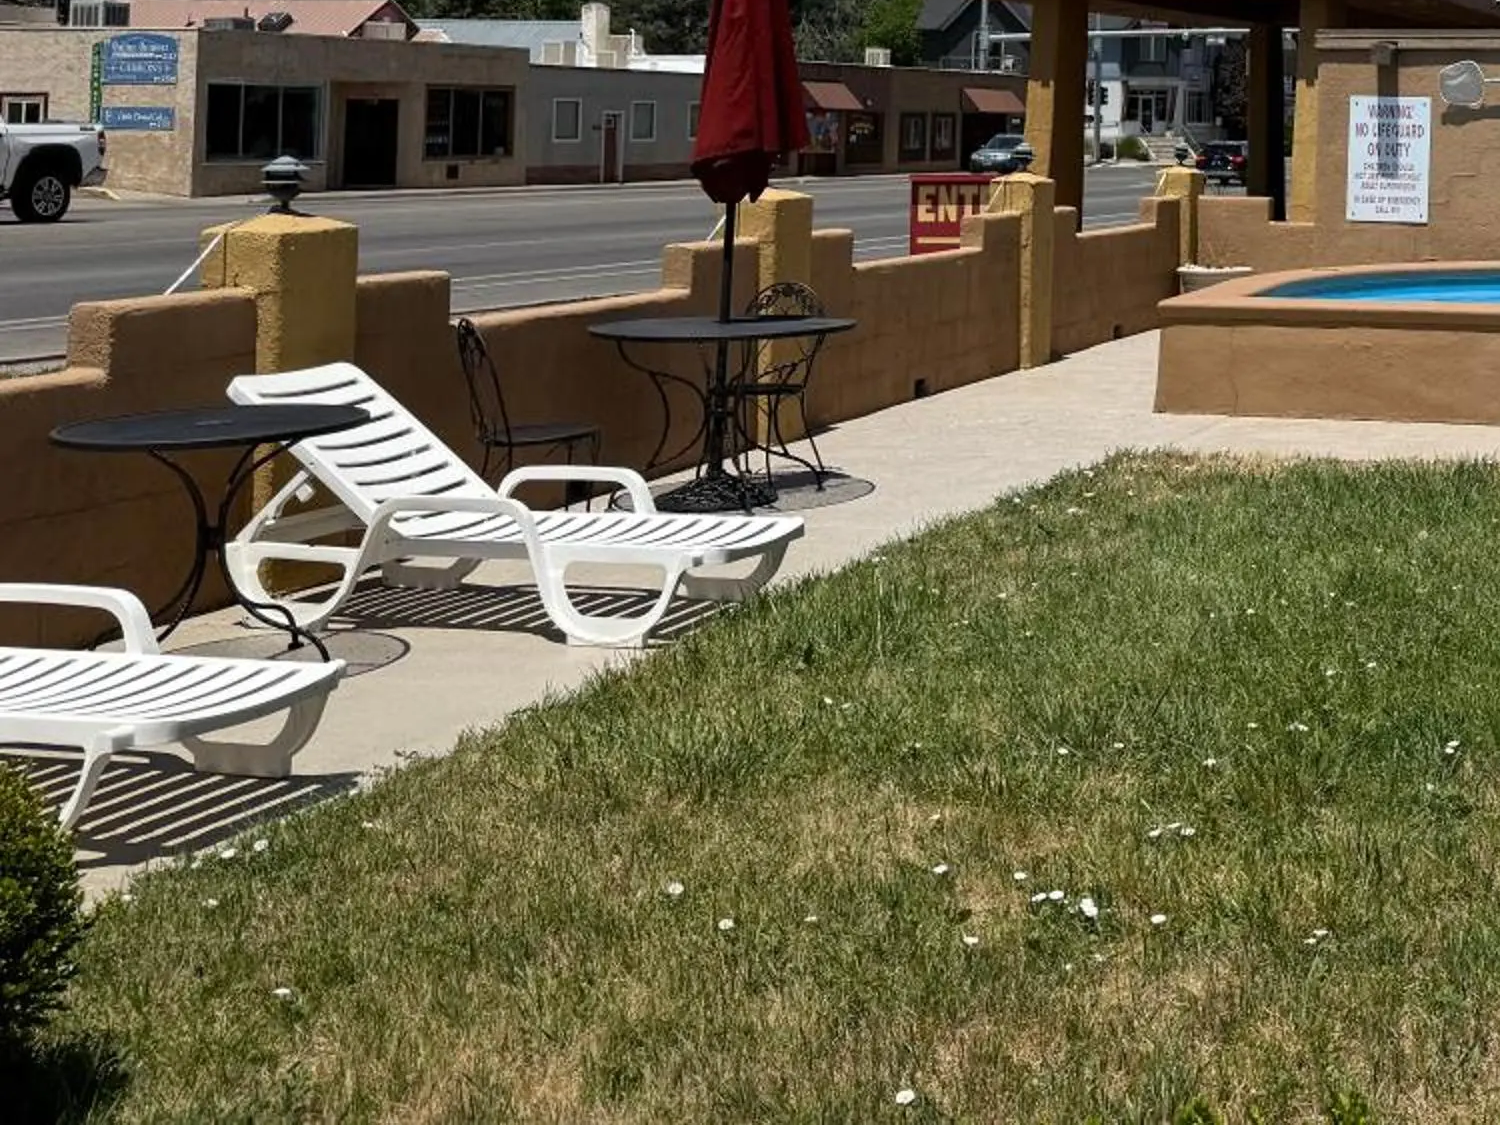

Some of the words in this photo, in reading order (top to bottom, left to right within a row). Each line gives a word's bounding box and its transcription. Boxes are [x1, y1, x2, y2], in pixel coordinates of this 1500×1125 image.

[1355, 123, 1369, 138] NO
[1373, 123, 1425, 138] LIFEGUARD
[1385, 142, 1411, 157] DUTY
